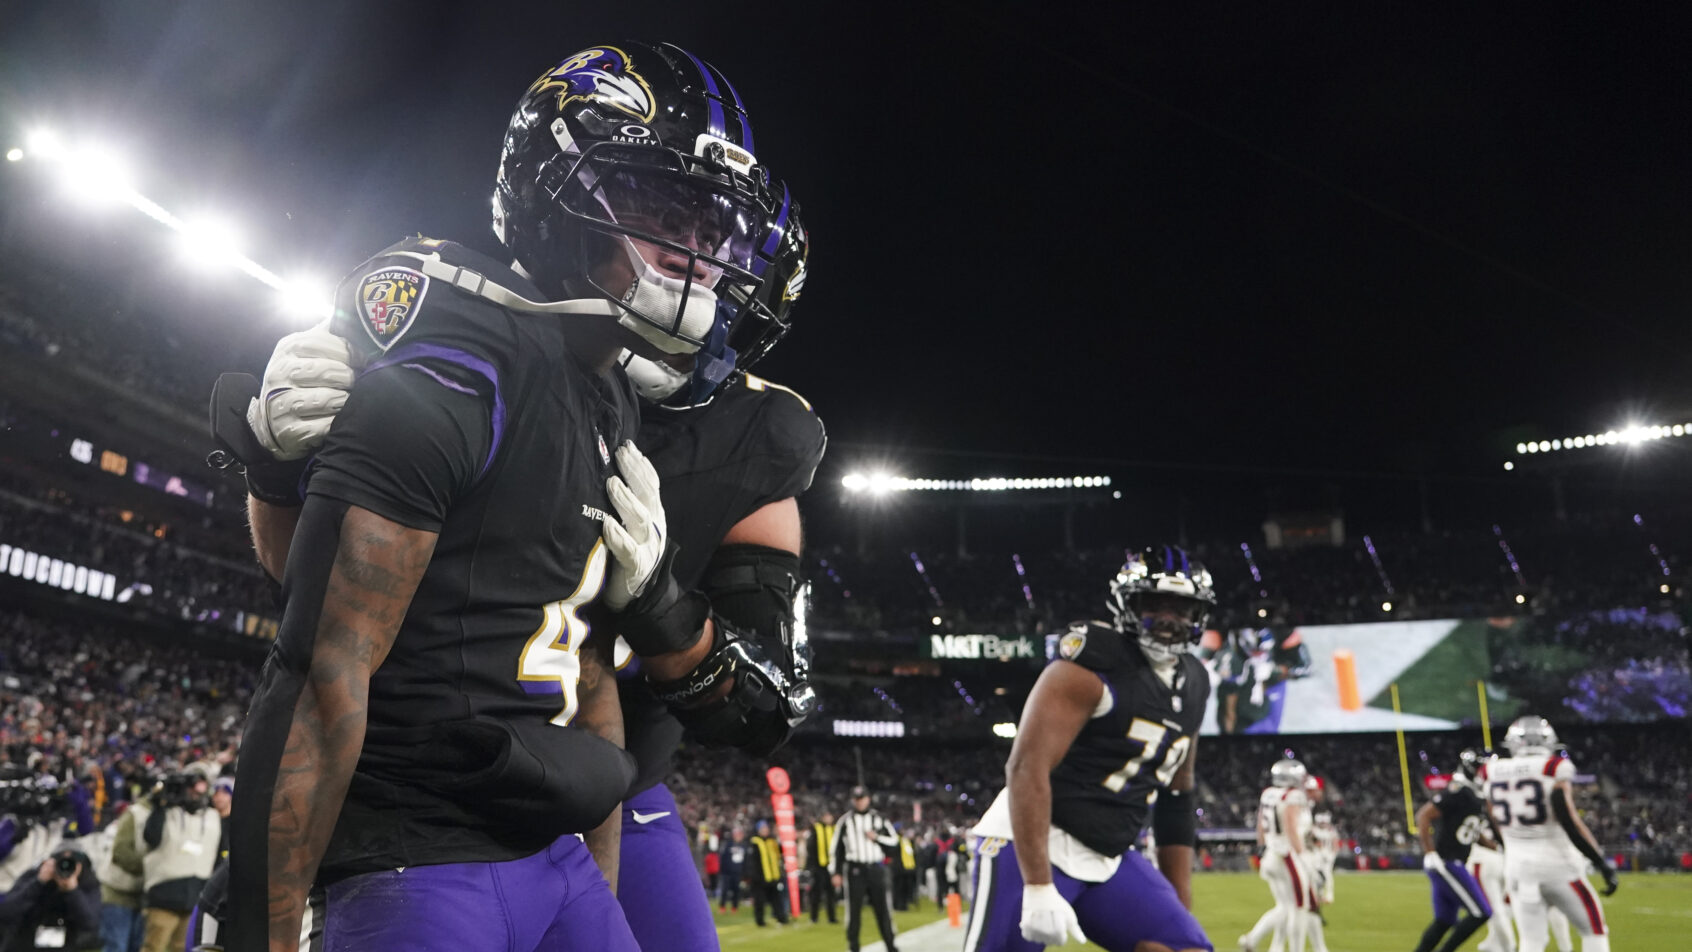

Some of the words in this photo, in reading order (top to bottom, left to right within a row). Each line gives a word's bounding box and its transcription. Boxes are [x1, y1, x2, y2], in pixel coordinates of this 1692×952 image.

[612, 135, 657, 145] OAKLEY
[368, 272, 419, 284] RAVENS
[582, 504, 608, 521] RAVEN
[517, 536, 608, 727] 4
[931, 634, 983, 658] M&T
[982, 634, 1035, 658] Bank
[1489, 778, 1548, 826] 53
